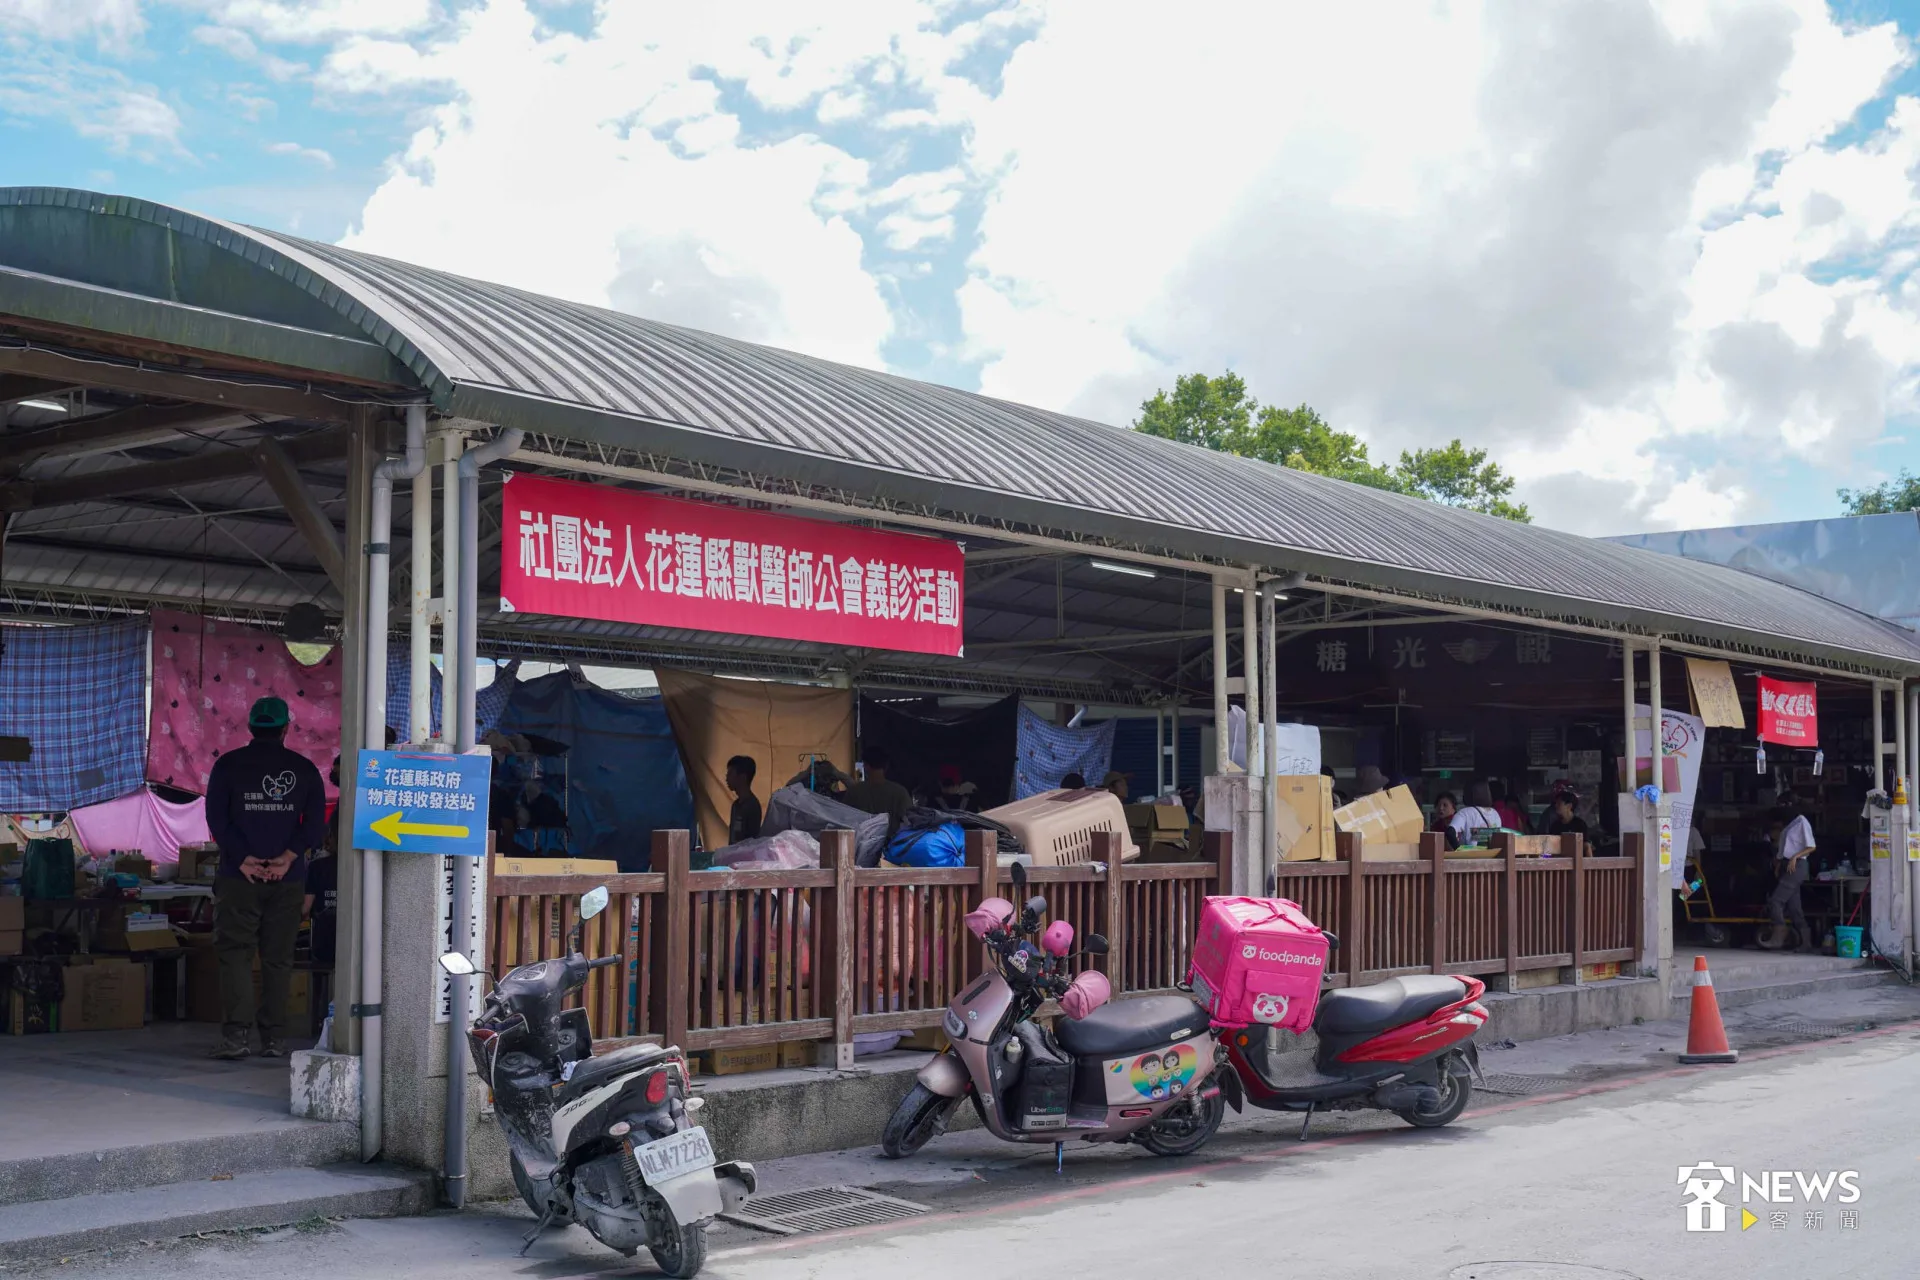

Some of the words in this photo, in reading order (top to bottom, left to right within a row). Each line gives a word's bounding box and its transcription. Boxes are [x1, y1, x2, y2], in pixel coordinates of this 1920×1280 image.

[519, 510, 960, 628] 社團法人花蓮縣獸醫師公會義診活動
[384, 767, 462, 789] 花蓮縣政府
[244, 792, 264, 800] 花蓮縣
[367, 788, 476, 812] 物資接收發送站
[1258, 947, 1322, 966] foodpanda
